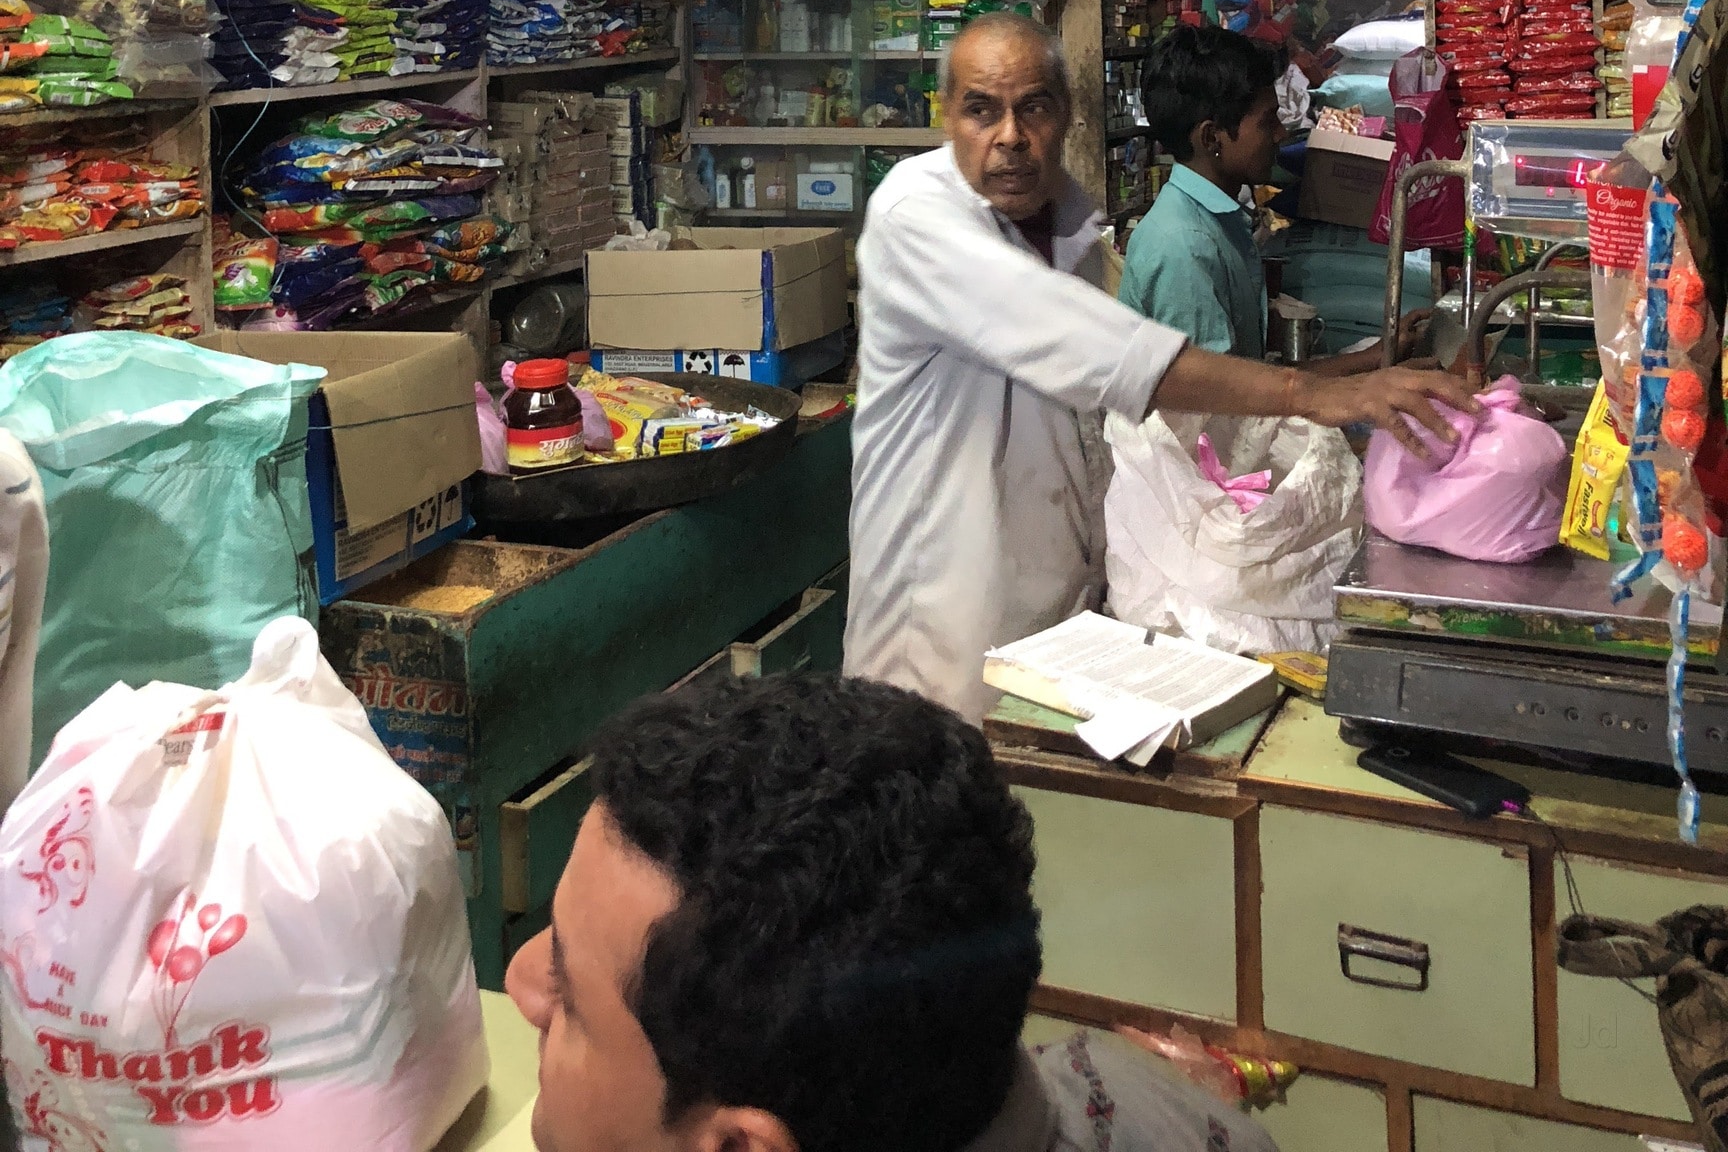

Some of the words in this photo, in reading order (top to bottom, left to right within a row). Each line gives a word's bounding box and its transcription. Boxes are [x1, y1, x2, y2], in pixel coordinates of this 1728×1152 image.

[1596, 188, 1637, 211] Organic
[604, 354, 632, 362] RAVINDRA
[633, 355, 673, 363] ENTERPRISES
[79, 1006, 109, 1029] DAY
[36, 1019, 272, 1084] Thank
[138, 1075, 284, 1126] You
